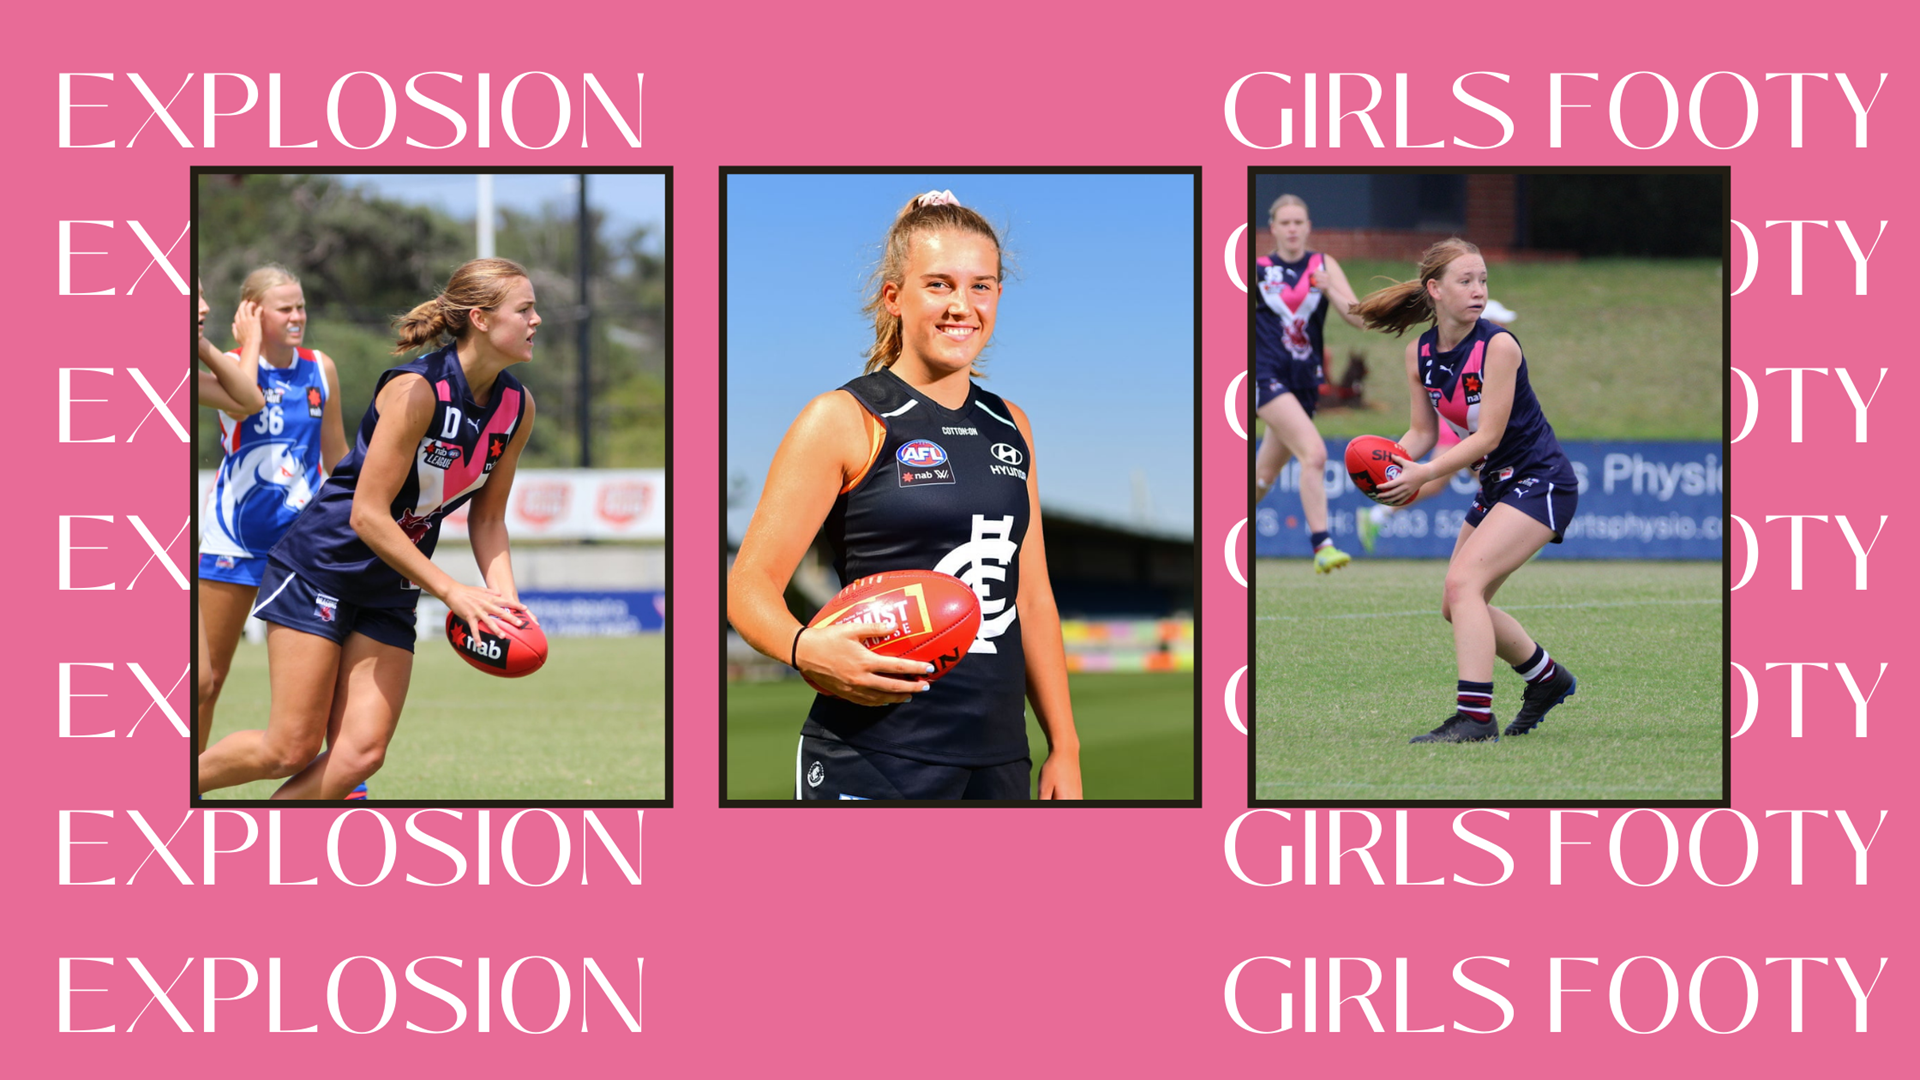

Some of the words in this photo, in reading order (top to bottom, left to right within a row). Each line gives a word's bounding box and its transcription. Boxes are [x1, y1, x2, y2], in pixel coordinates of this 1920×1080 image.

[253, 404, 284, 436] 36
[440, 405, 462, 439] D
[903, 446, 943, 461] AFL
[914, 471, 932, 480] nab
[1603, 453, 1723, 501] Physi
[466, 635, 502, 660] nab
